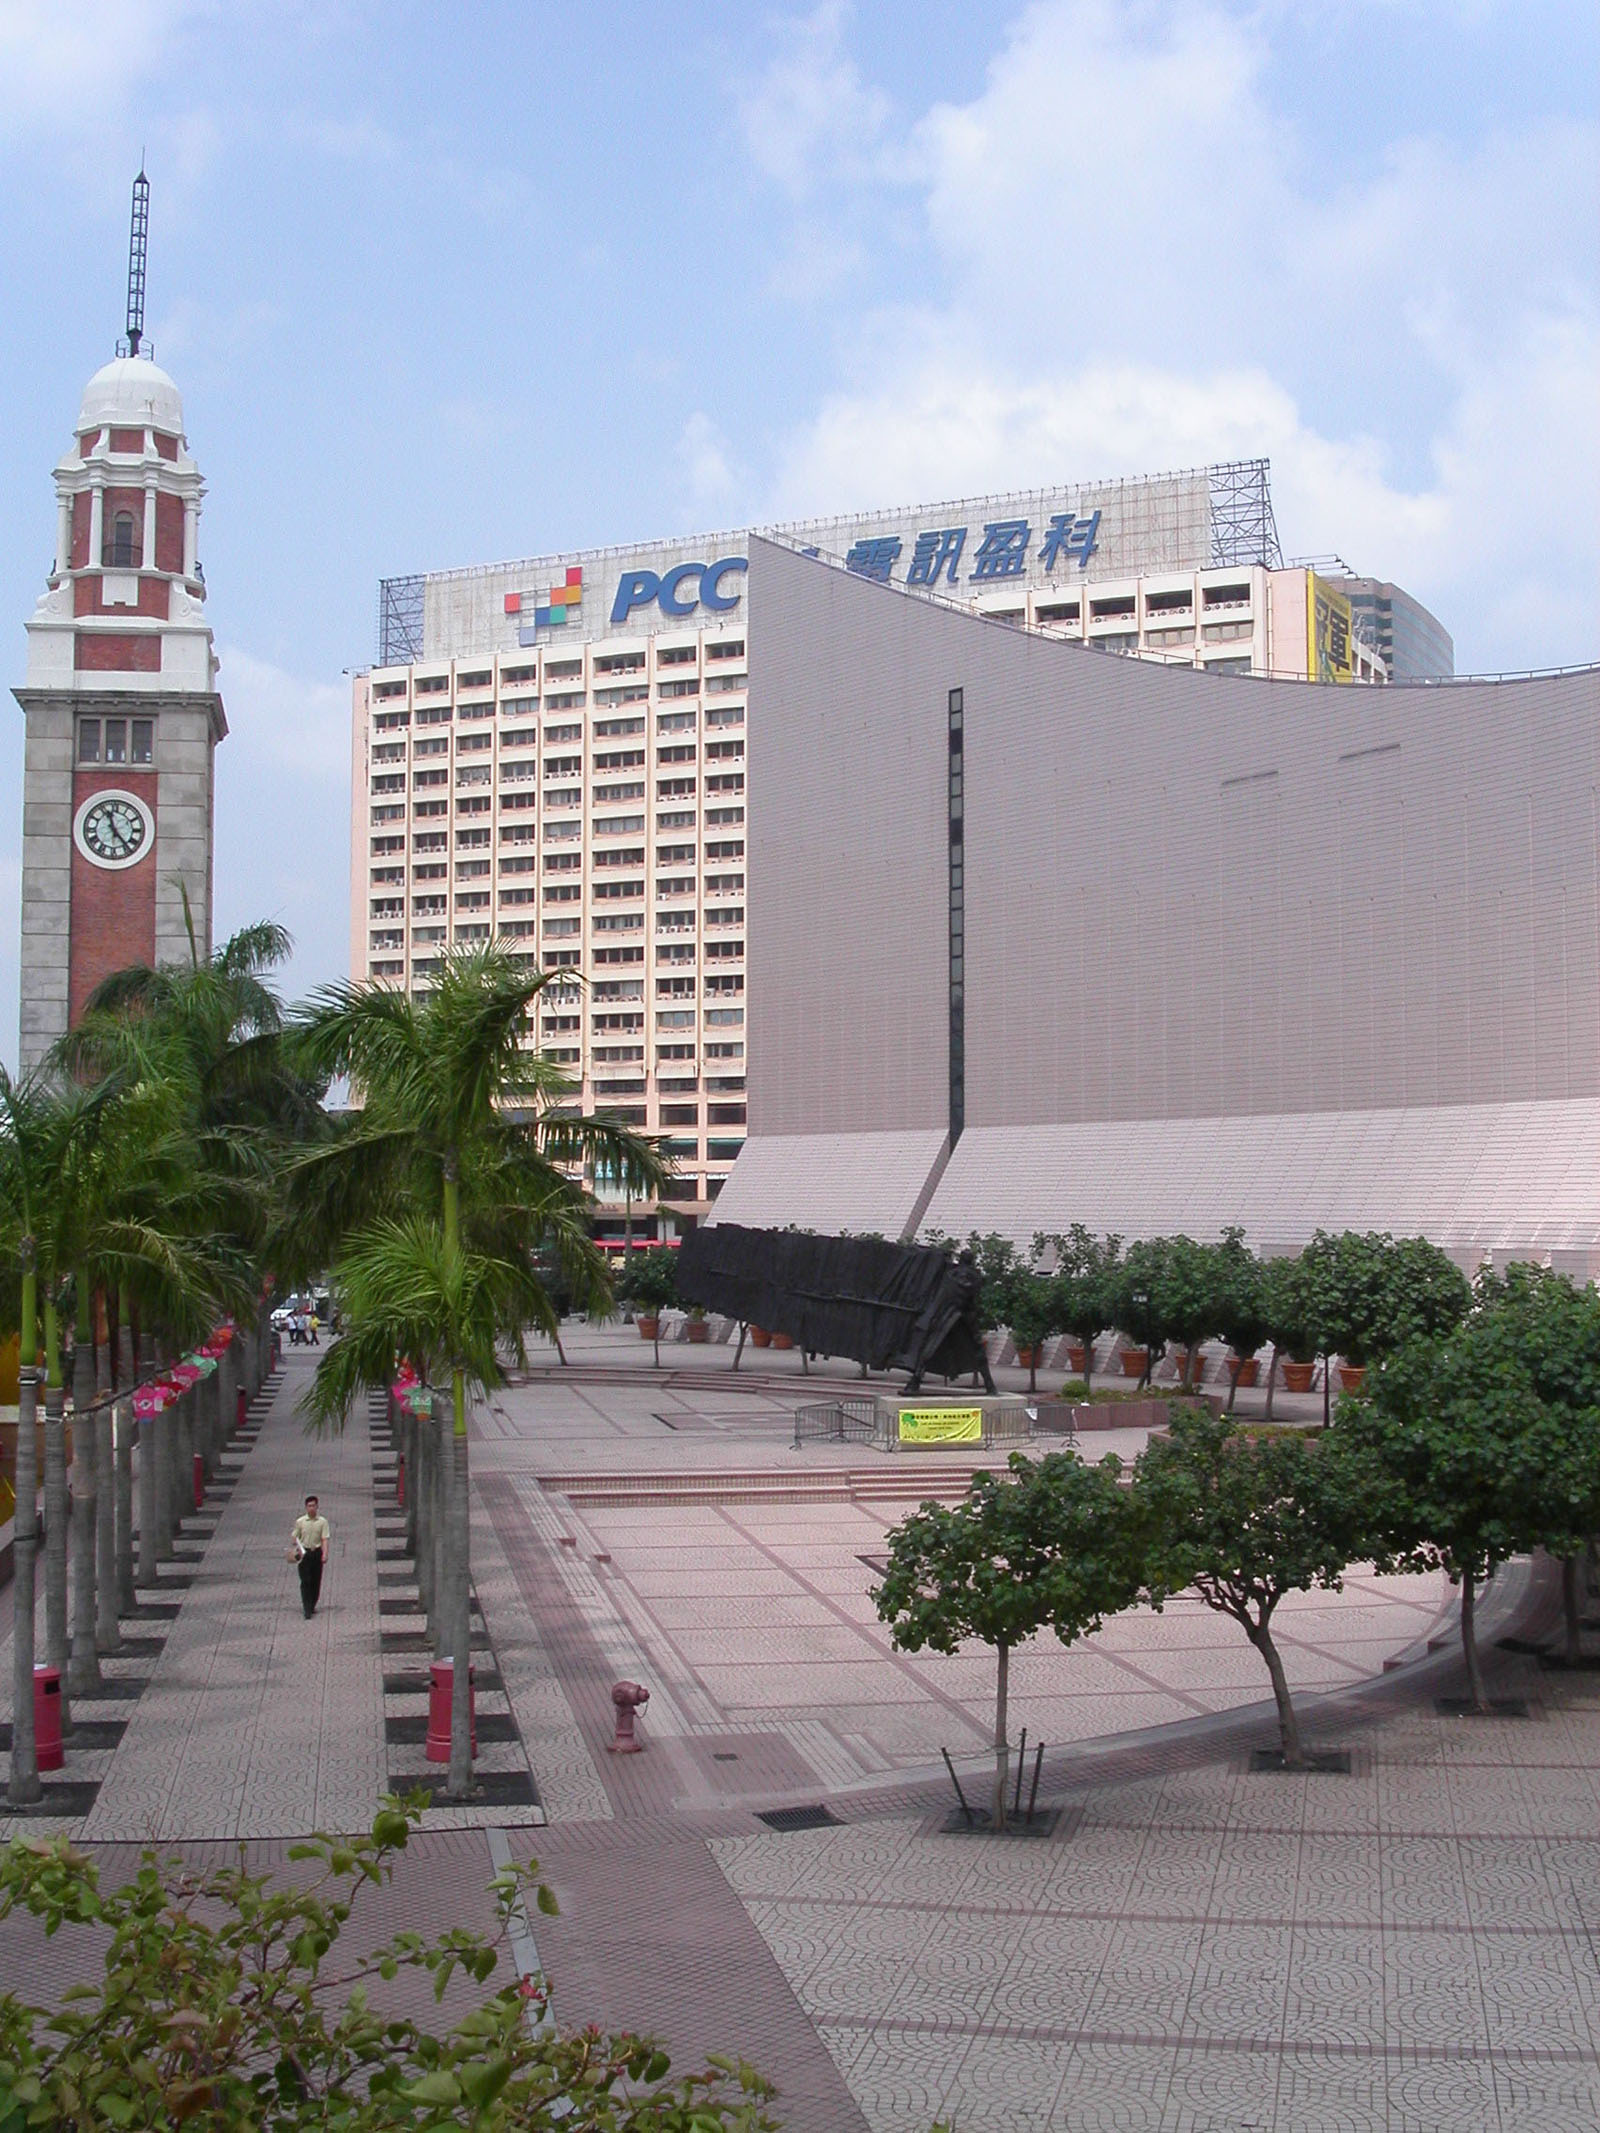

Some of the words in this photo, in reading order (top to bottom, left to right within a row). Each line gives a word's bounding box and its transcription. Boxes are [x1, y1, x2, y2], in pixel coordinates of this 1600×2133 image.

[846, 509, 1102, 586] 電訊盈科
[610, 556, 749, 622] PCC
